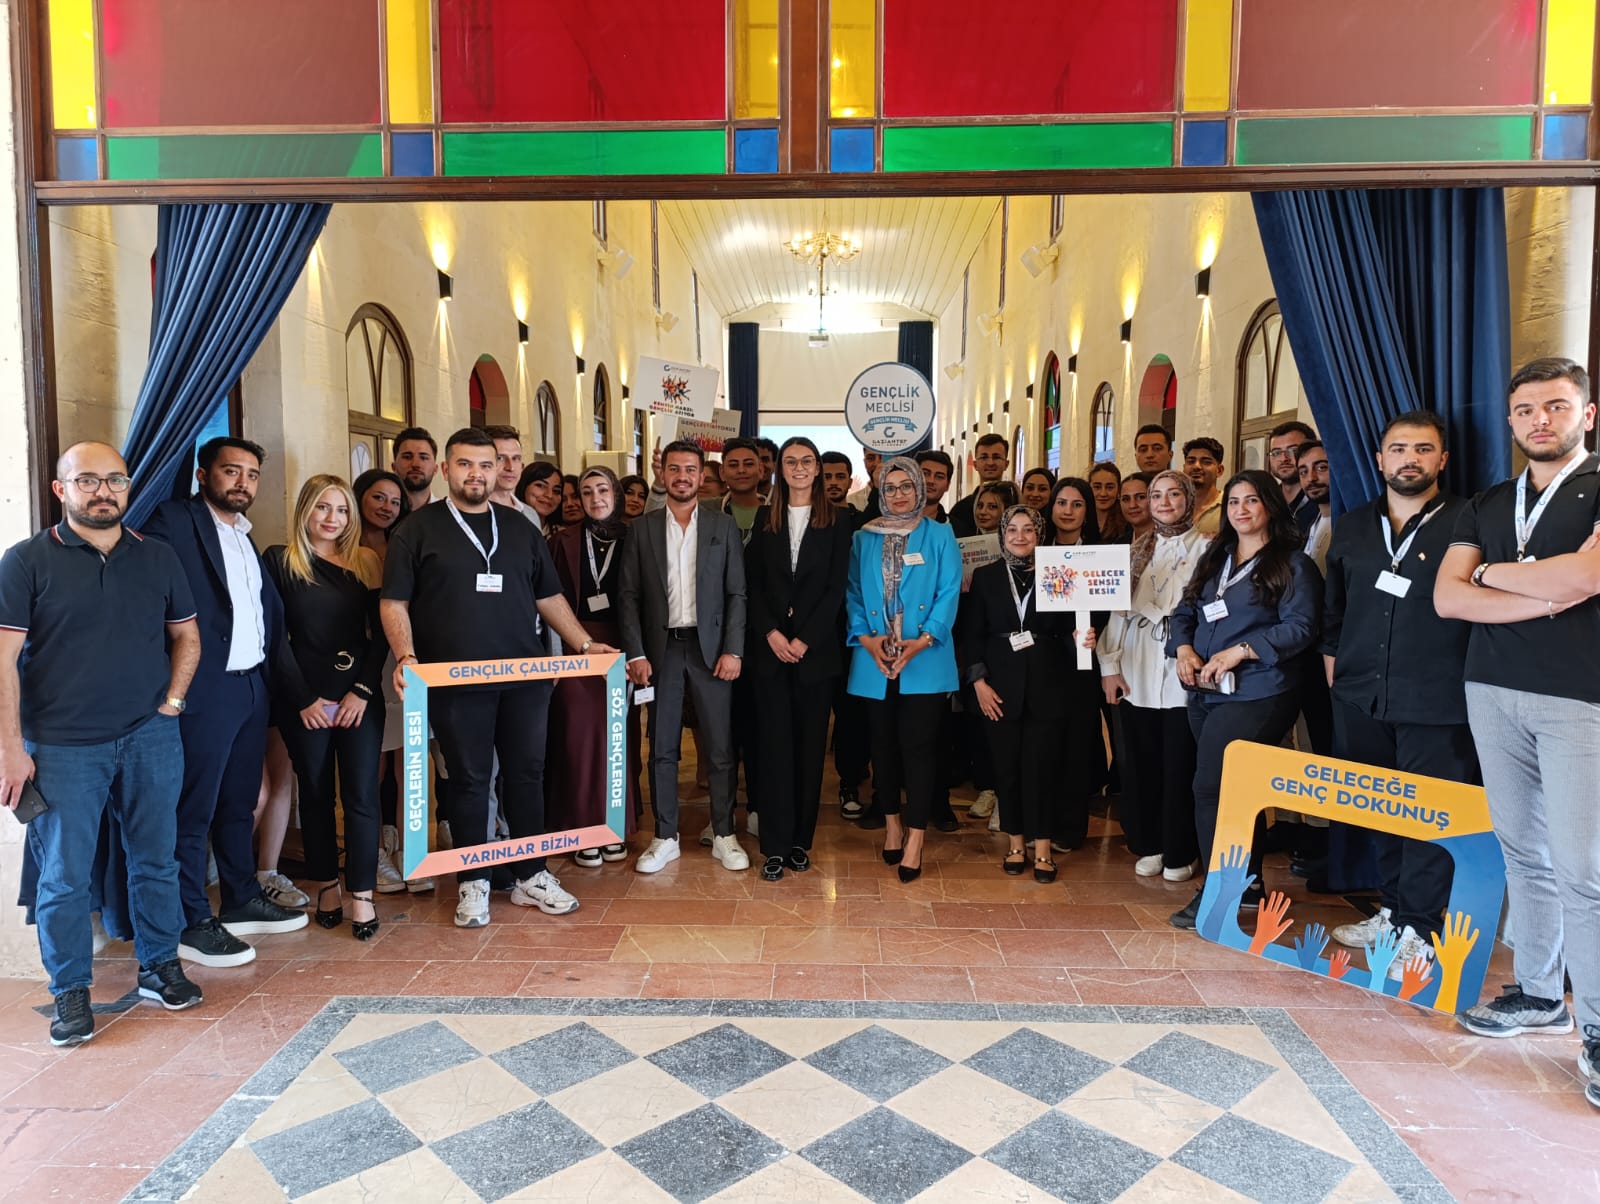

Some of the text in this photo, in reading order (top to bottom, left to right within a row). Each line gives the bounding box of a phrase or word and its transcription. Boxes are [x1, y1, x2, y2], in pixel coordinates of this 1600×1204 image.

[860, 384, 920, 399] GENÇLİK
[865, 399, 914, 413] MECLİSİ
[1082, 569, 1126, 578] GELECEK
[1087, 577, 1121, 586] SENSİZ
[1088, 587, 1117, 595] EKSİK
[448, 658, 590, 680] GENÇLİK ÇALIŞTAYI
[609, 687, 623, 808] SÖZ GENÇLERDE
[407, 710, 426, 832] GEÇLERİN SESİ
[1303, 763, 1417, 800] GELECEĞE
[1270, 776, 1451, 831] GENÇ DOKUNUŞ
[460, 835, 580, 866] YARINLAR BİZİM
